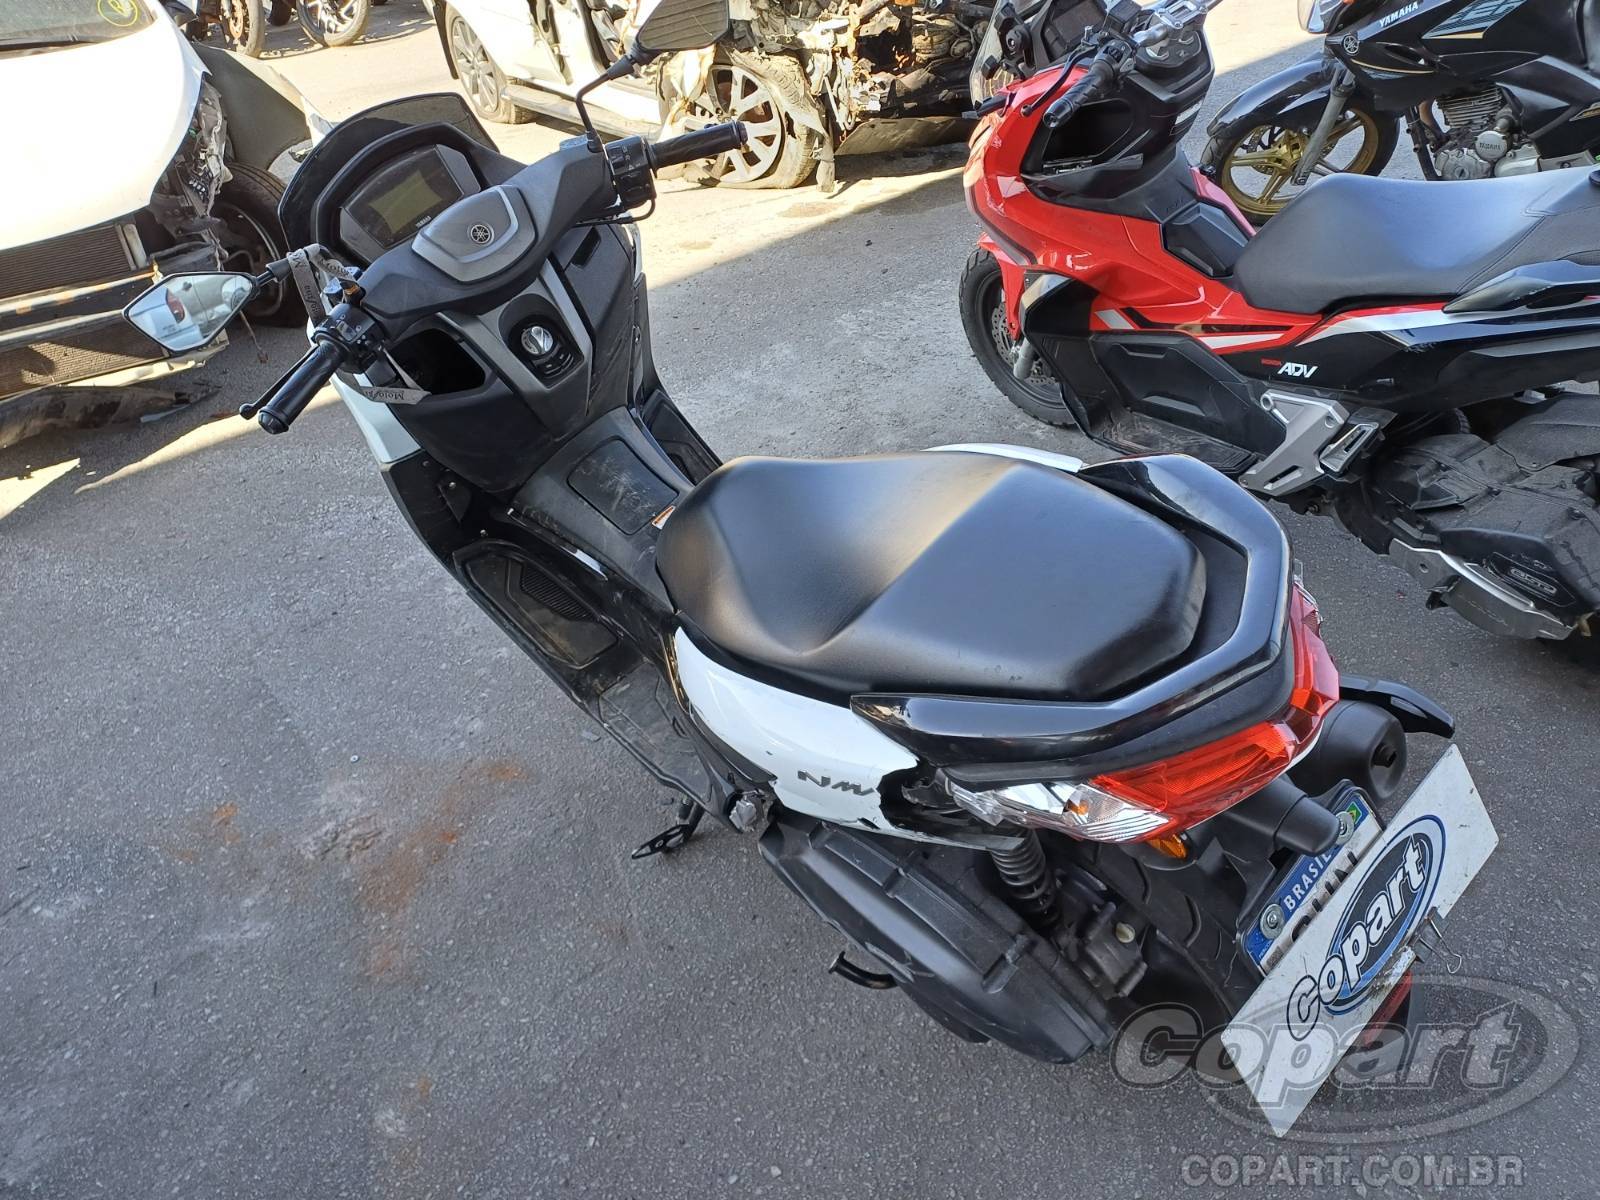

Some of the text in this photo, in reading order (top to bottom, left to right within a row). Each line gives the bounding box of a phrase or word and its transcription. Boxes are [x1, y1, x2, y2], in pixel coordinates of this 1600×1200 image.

[1378, 3, 1419, 27] YAMAHA
[1277, 362, 1318, 378] ADV
[1287, 834, 1427, 1042] Copart
